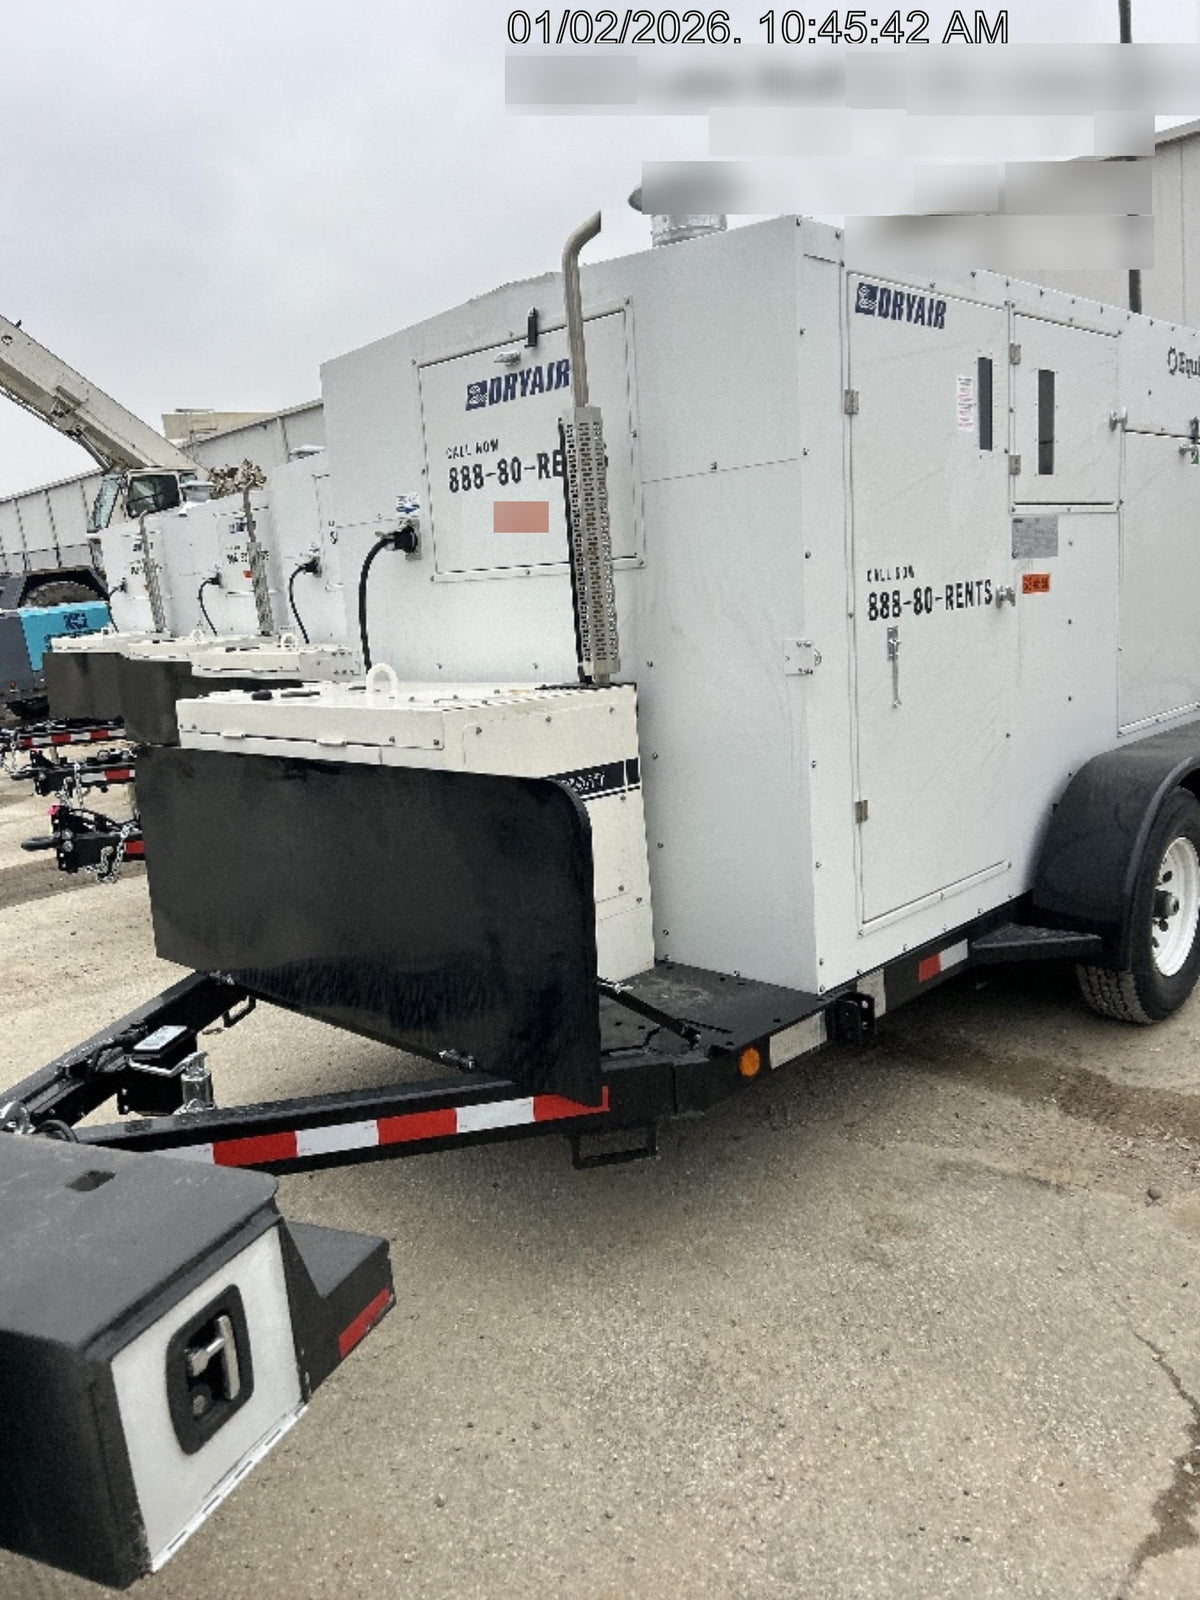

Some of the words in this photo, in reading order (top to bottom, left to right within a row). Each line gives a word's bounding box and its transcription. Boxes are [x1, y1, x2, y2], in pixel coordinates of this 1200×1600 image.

[878, 287, 947, 330] DRYAIR
[488, 358, 570, 406] DRYAIR
[446, 443, 472, 459] CALL
[868, 578, 993, 621] 888-80-RENTS
